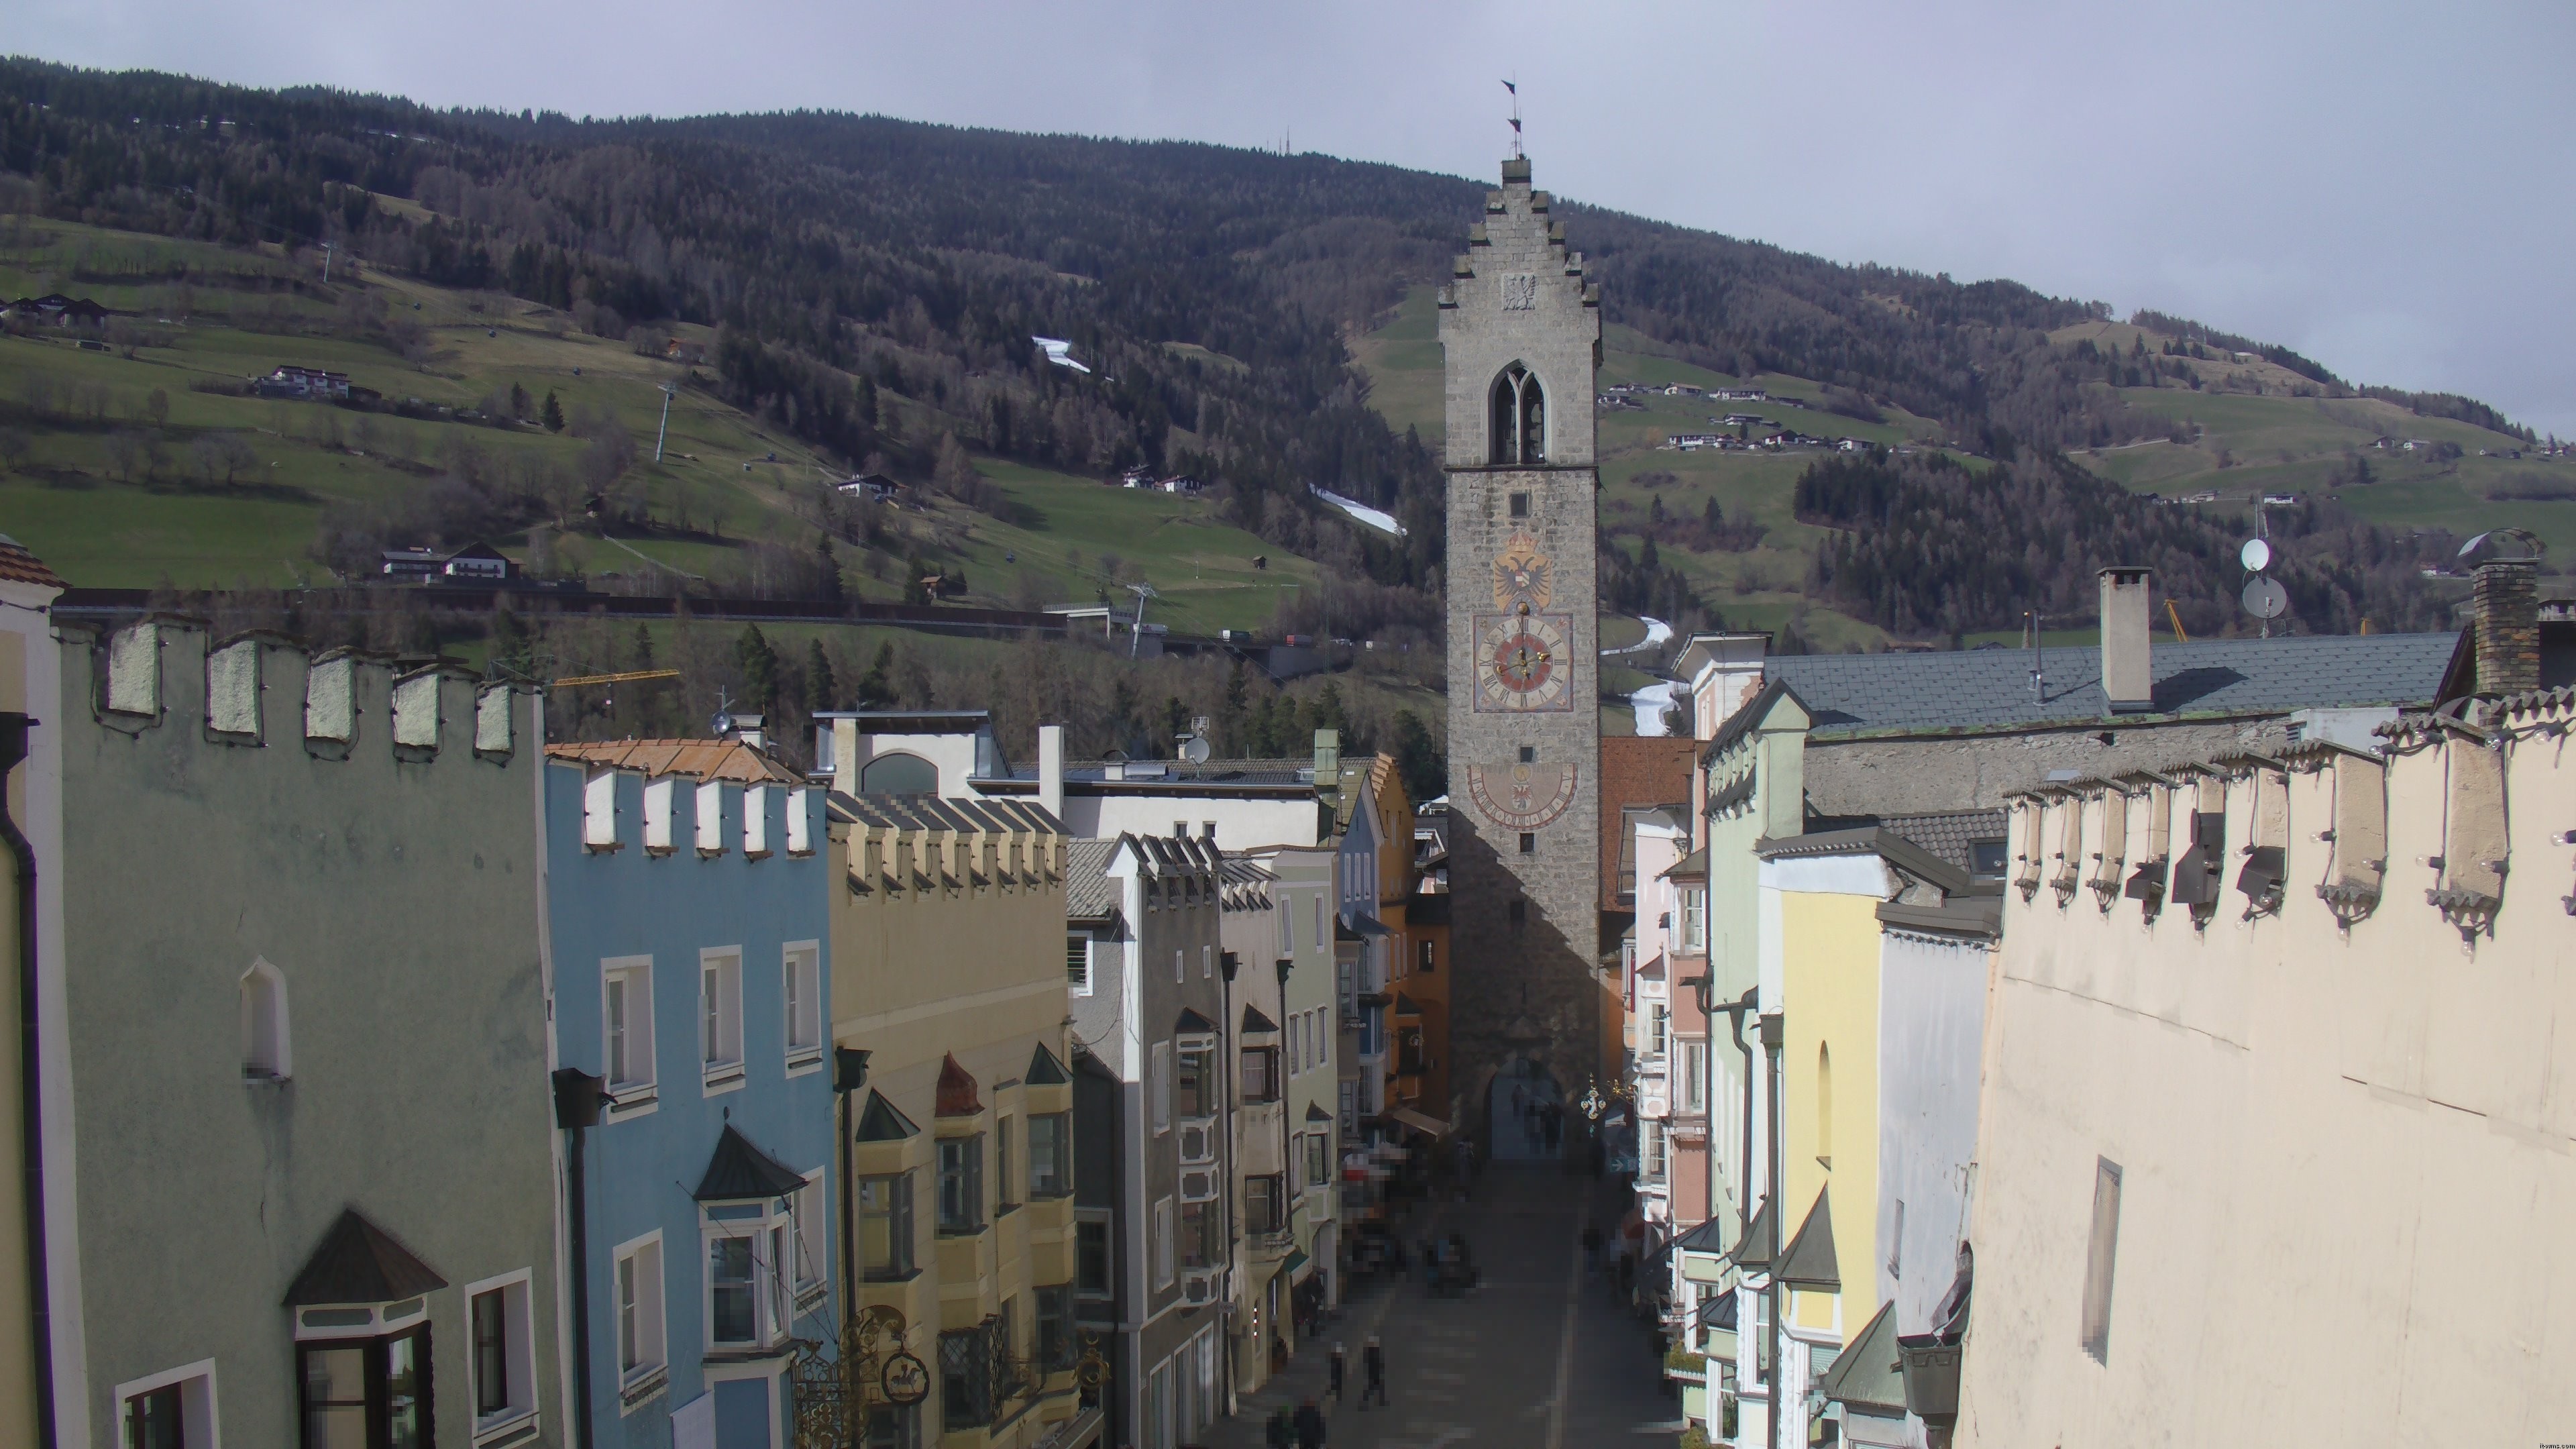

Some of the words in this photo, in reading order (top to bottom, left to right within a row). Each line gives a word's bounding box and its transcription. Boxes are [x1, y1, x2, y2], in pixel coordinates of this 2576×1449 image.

[1538, 623, 1546, 636] I
[1549, 639, 1562, 648] II
[1538, 690, 1548, 704] V
